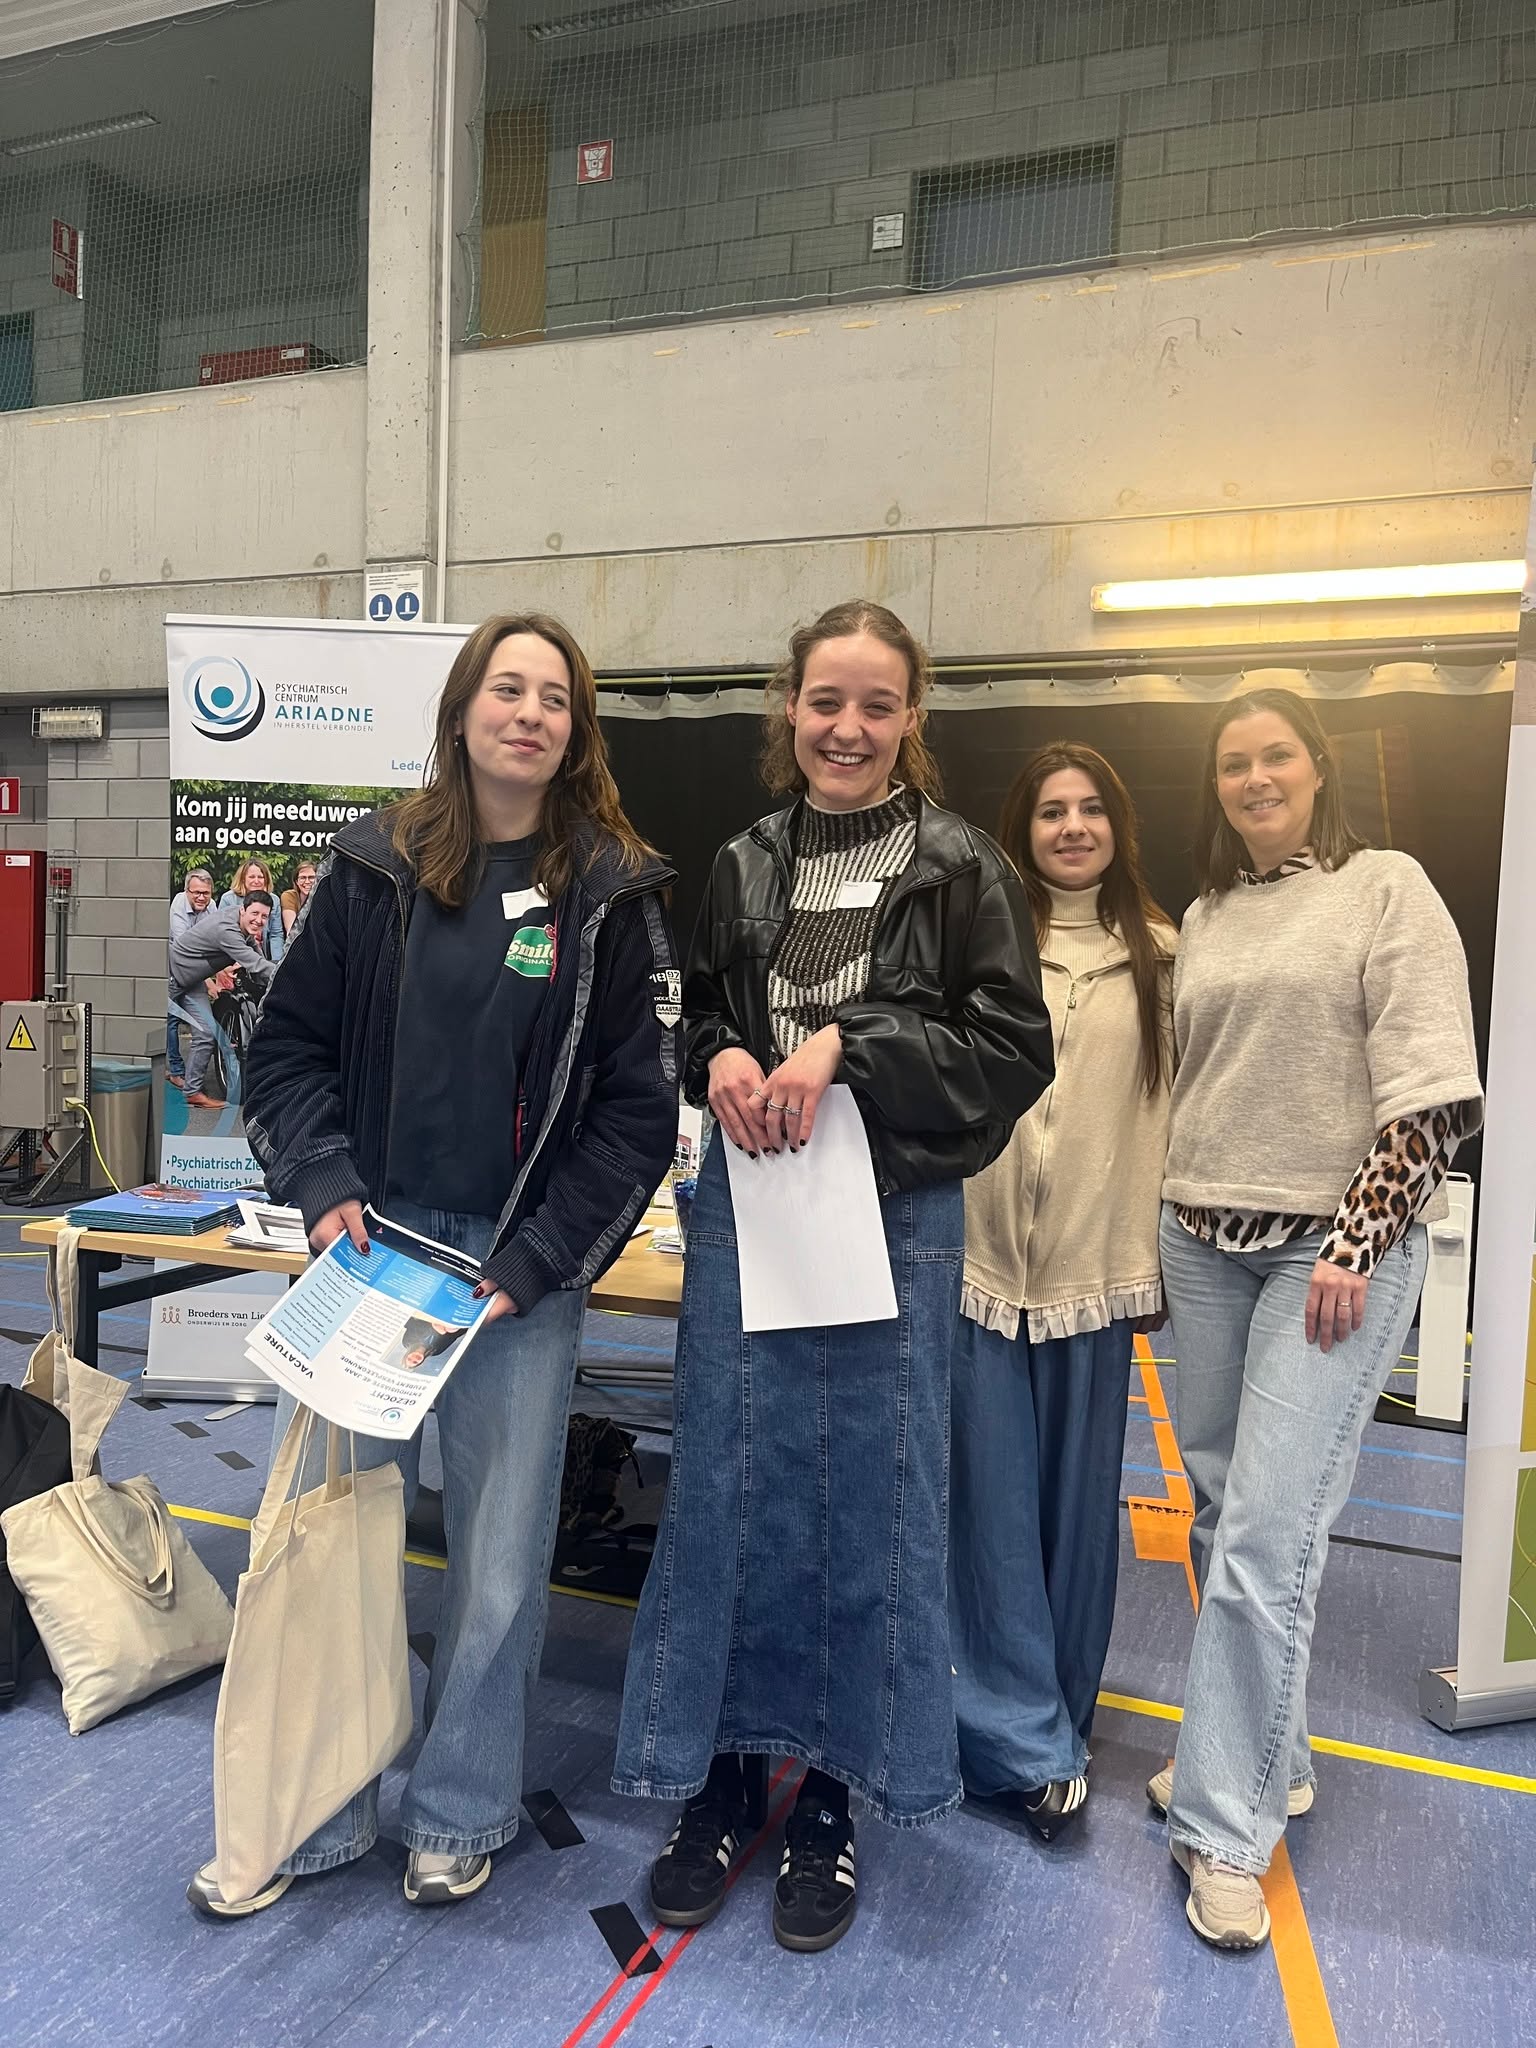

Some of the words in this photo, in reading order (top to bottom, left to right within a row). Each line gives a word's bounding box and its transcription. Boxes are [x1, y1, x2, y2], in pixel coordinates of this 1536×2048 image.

[275, 683, 348, 695] PSYCHIATRISCH
[275, 693, 319, 703] CENTRUM
[274, 704, 374, 723] ARIADNE
[323, 724, 374, 732] VERBONDEN
[391, 759, 422, 771] Lede
[176, 794, 221, 817] Kom
[225, 796, 247, 824] jij
[175, 826, 210, 843] aan
[215, 824, 284, 849] goede
[507, 954, 553, 966] ORIGINAL
[171, 1155, 242, 1171] Psychiatrisch
[170, 1175, 242, 1190] Psychiatrisch
[188, 1308, 229, 1319] Broeders
[231, 1312, 248, 1320] van
[251, 1311, 268, 1320] Lie
[263, 1332, 315, 1379] VACATURE
[344, 1367, 363, 1378] JAAR
[370, 1390, 416, 1406] GEZOCHT
